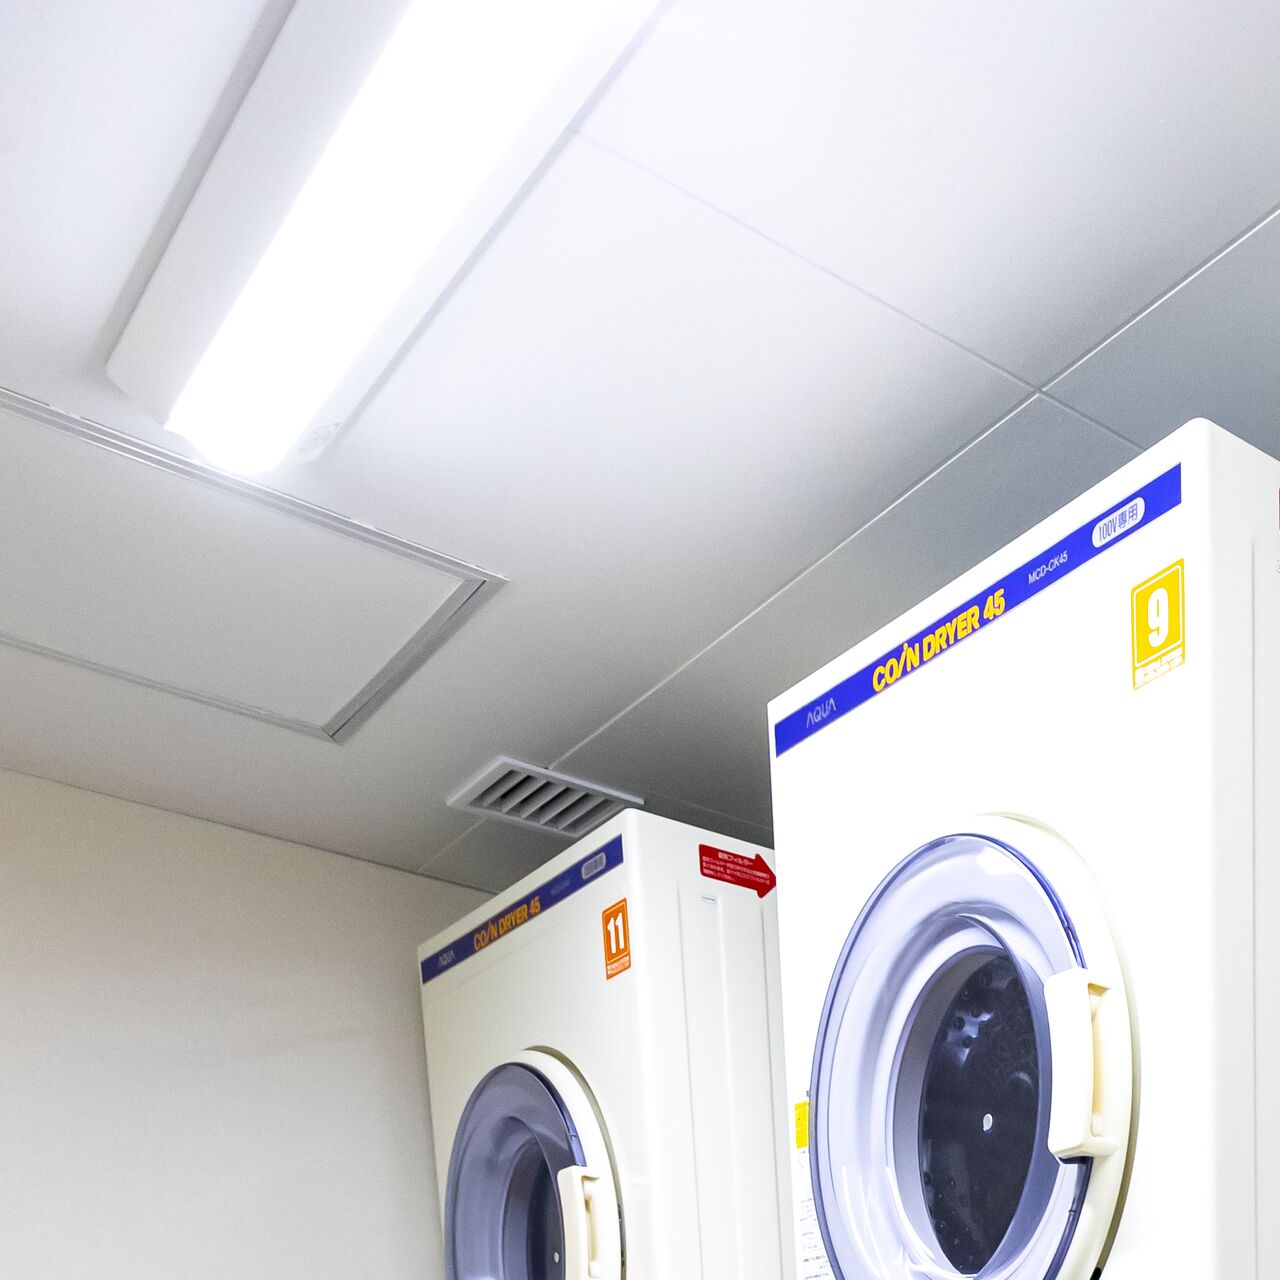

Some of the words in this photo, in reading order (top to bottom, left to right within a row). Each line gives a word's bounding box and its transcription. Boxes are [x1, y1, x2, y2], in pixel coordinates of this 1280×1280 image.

[922, 605, 981, 659] DRYER
[983, 588, 1006, 621] 45
[1147, 587, 1169, 648] 9
[806, 697, 836, 729] AQUA
[499, 903, 528, 936] DRYER
[529, 895, 541, 916] 45
[607, 912, 625, 954] 11
